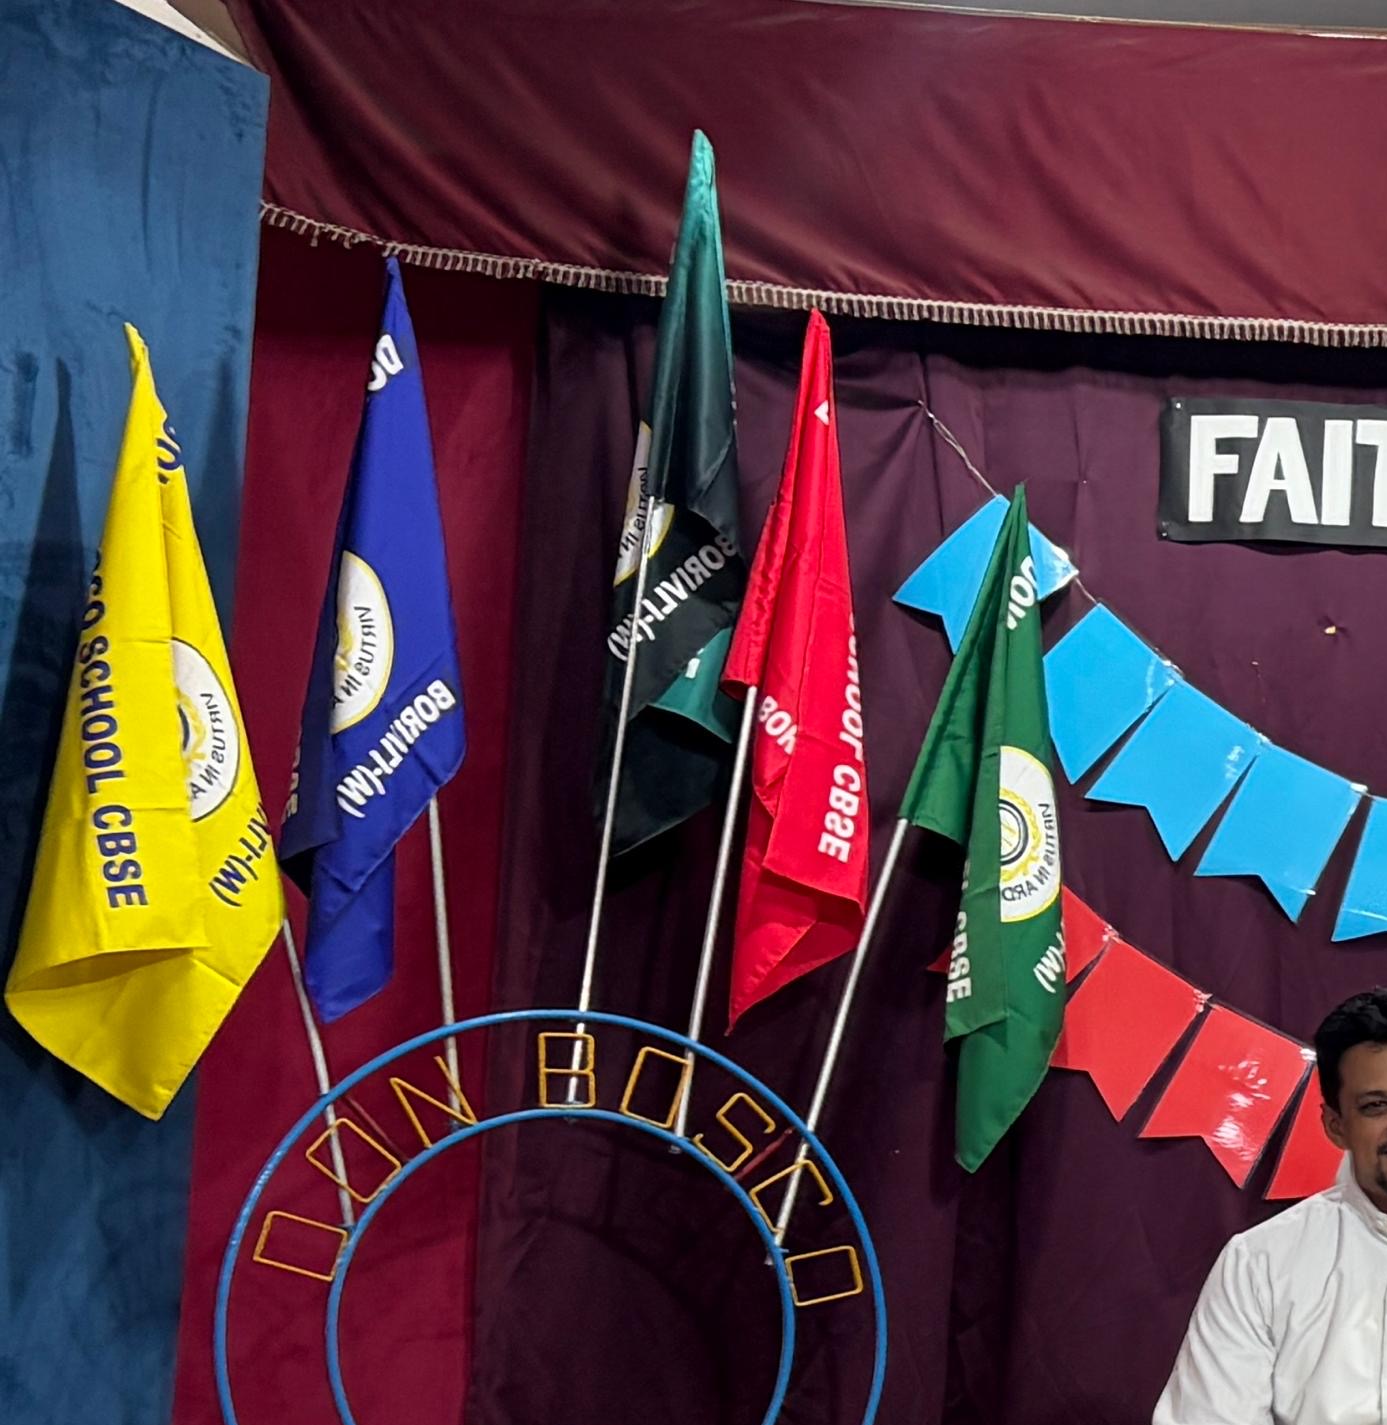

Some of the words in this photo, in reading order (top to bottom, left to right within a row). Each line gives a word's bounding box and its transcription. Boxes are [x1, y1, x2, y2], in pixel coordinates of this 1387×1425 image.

[79, 635, 127, 796] SCHOOL
[92, 804, 150, 909] CBSE
[537, 1031, 863, 1307] BOSCO
